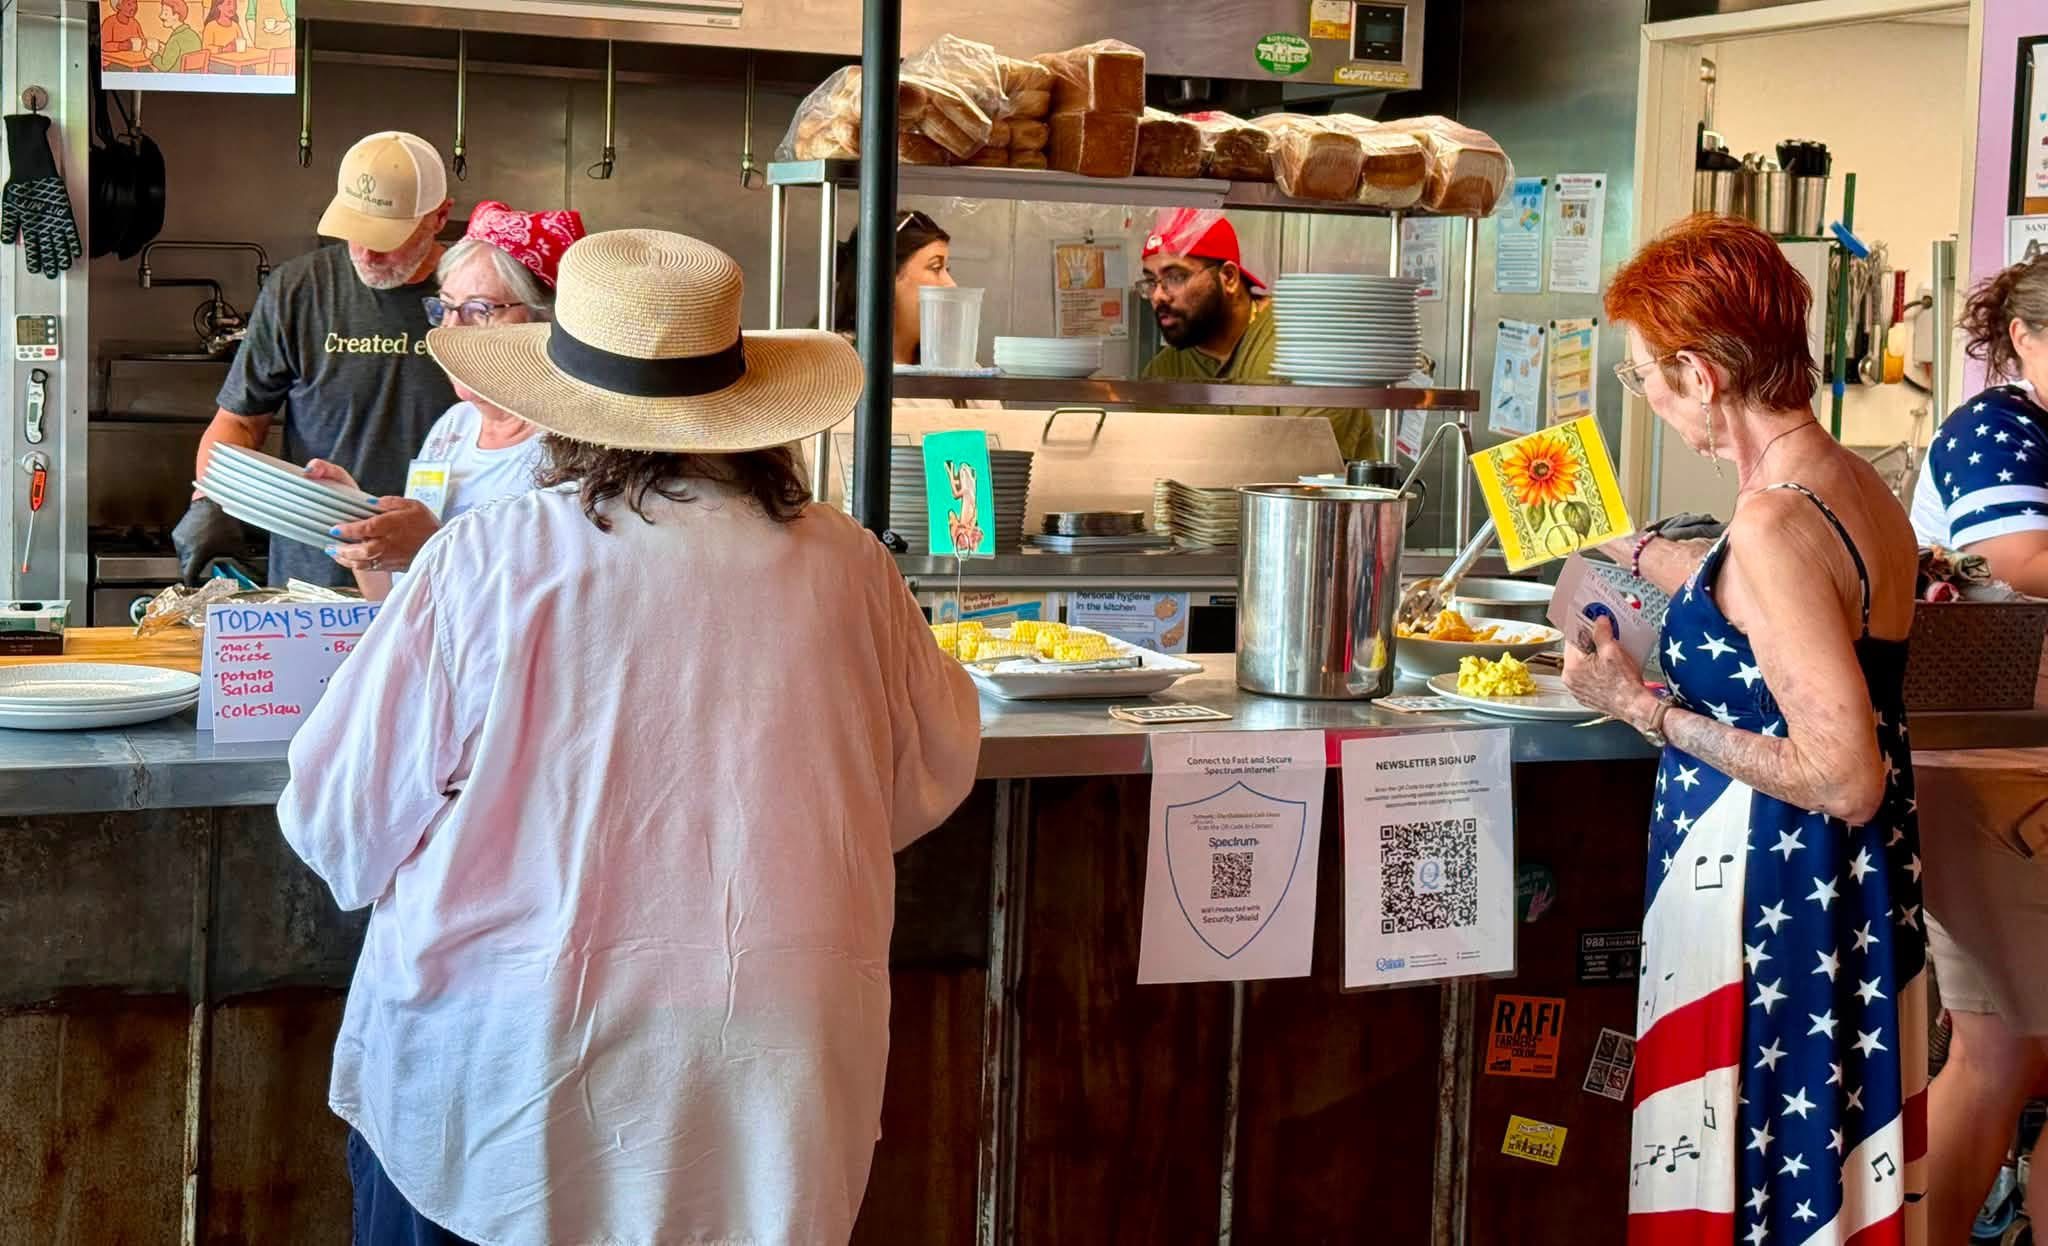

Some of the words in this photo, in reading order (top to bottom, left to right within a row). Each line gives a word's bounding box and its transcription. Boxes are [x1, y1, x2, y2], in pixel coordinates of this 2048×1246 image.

[324, 332, 408, 353] Created
[1118, 592, 1151, 603] hygiene
[1086, 602, 1101, 610] the
[1104, 602, 1136, 611] kitchen
[211, 608, 313, 637] TODAY'S
[1187, 757, 1220, 766] Connect
[1222, 757, 1231, 765] to
[1232, 756, 1249, 765] Fast
[1250, 756, 1264, 764] and
[1266, 755, 1292, 764] Secure
[1375, 758, 1437, 771] NEWSLETTER
[1438, 756, 1461, 767] SIGN
[1463, 754, 1477, 765] UP
[1204, 767, 1242, 776] Spectrum
[1202, 914, 1234, 924] Security
[1235, 912, 1259, 922] Shield
[1496, 1001, 1561, 1038] RAFI
